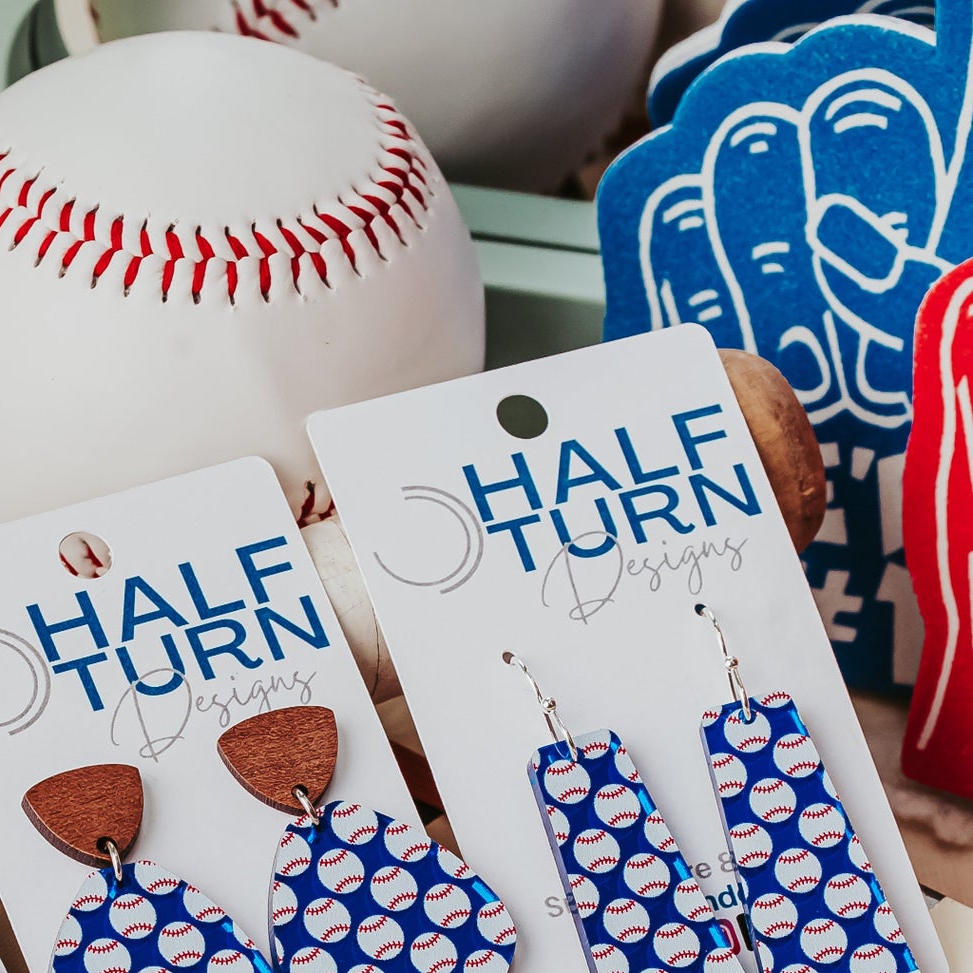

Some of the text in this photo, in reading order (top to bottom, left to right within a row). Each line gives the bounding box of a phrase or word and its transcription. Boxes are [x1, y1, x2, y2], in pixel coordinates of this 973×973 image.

[462, 404, 727, 522] HALF
[486, 463, 762, 573] TURN
[25, 535, 293, 662] HALF
[541, 531, 748, 625] Designs
[52, 595, 330, 711] TURN
[110, 668, 317, 763] Designs
